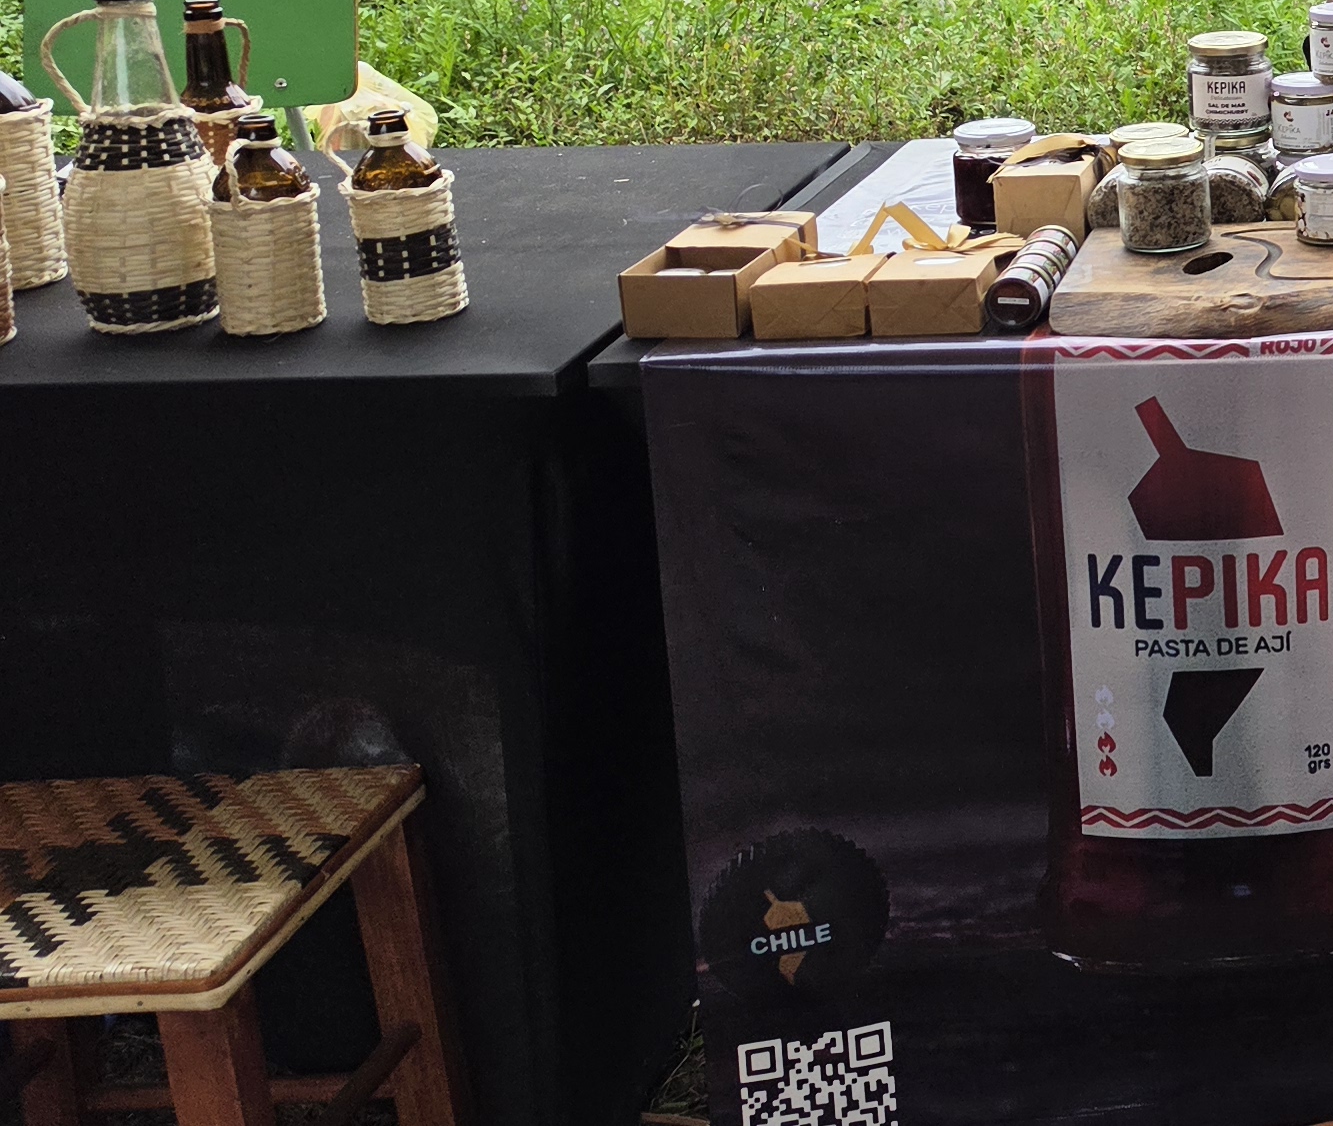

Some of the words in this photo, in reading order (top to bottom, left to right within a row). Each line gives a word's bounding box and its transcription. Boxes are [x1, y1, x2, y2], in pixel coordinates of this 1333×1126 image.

[1207, 80, 1246, 95] KEPIKA
[1260, 339, 1317, 355] ROJO
[1087, 546, 1329, 630] KEPIKA
[1134, 637, 1209, 659] PASTA
[1216, 636, 1249, 657] DE
[1254, 630, 1292, 654] AJÍ
[1304, 743, 1332, 759] 120
[1307, 757, 1332, 774] grs
[750, 923, 832, 955] CHILE
